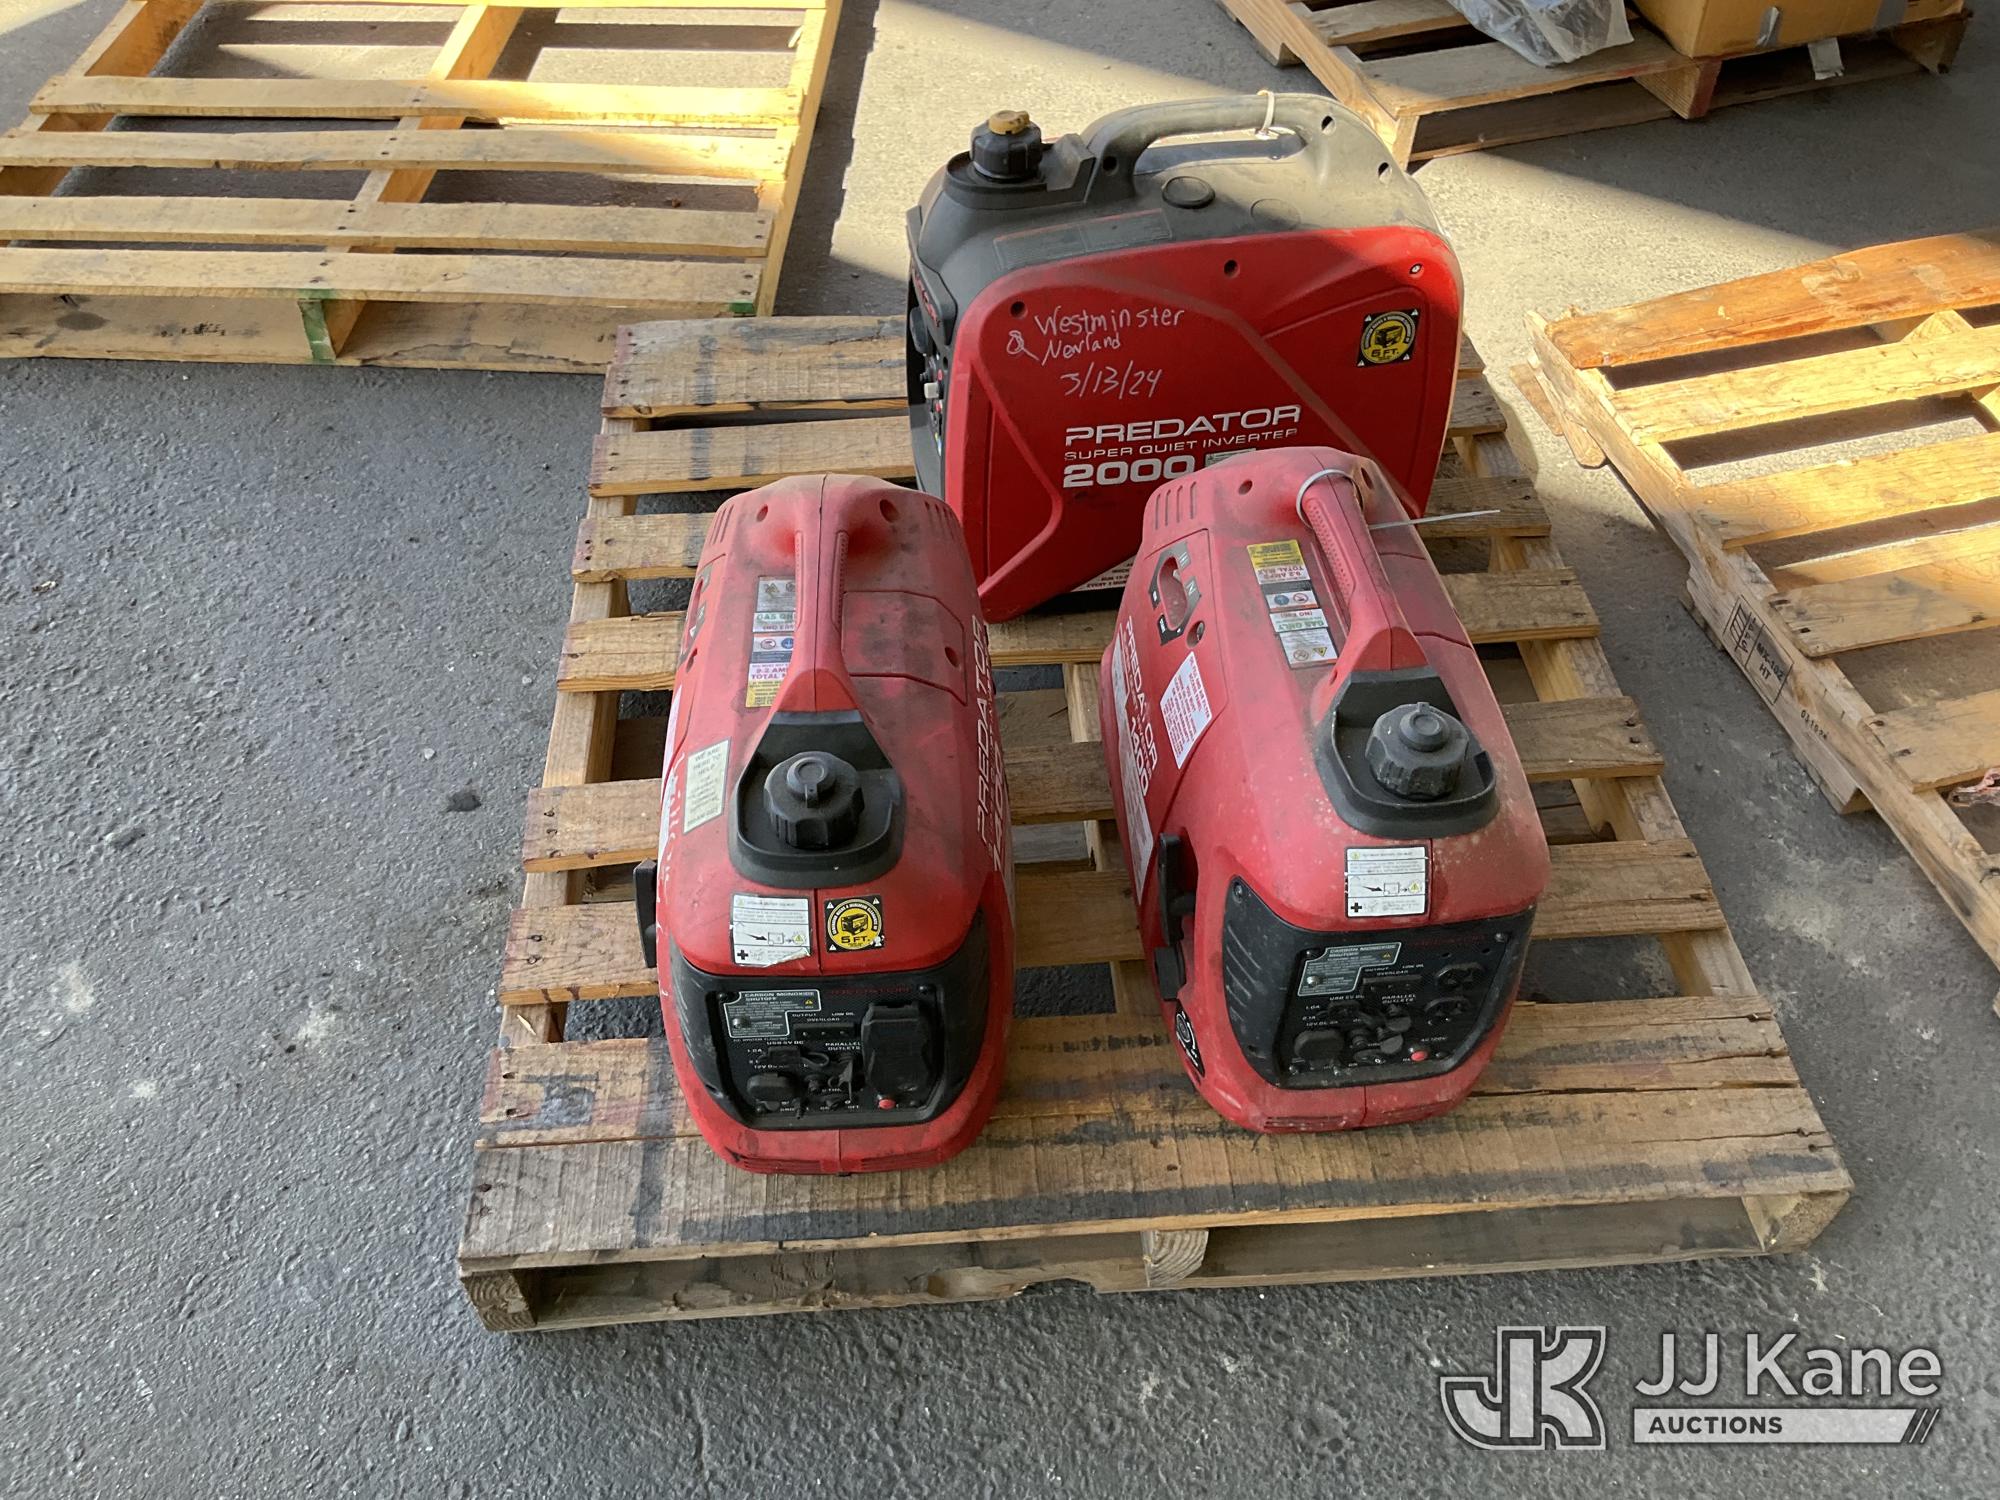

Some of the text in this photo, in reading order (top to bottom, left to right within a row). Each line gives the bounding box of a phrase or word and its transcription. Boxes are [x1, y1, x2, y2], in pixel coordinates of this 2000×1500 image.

[1034, 305, 1185, 336] Westminster
[1066, 404, 1301, 446] PREDATOR
[1064, 428, 1298, 461] SUPER QUIET INVERTER
[1063, 455, 1195, 488] 2000
